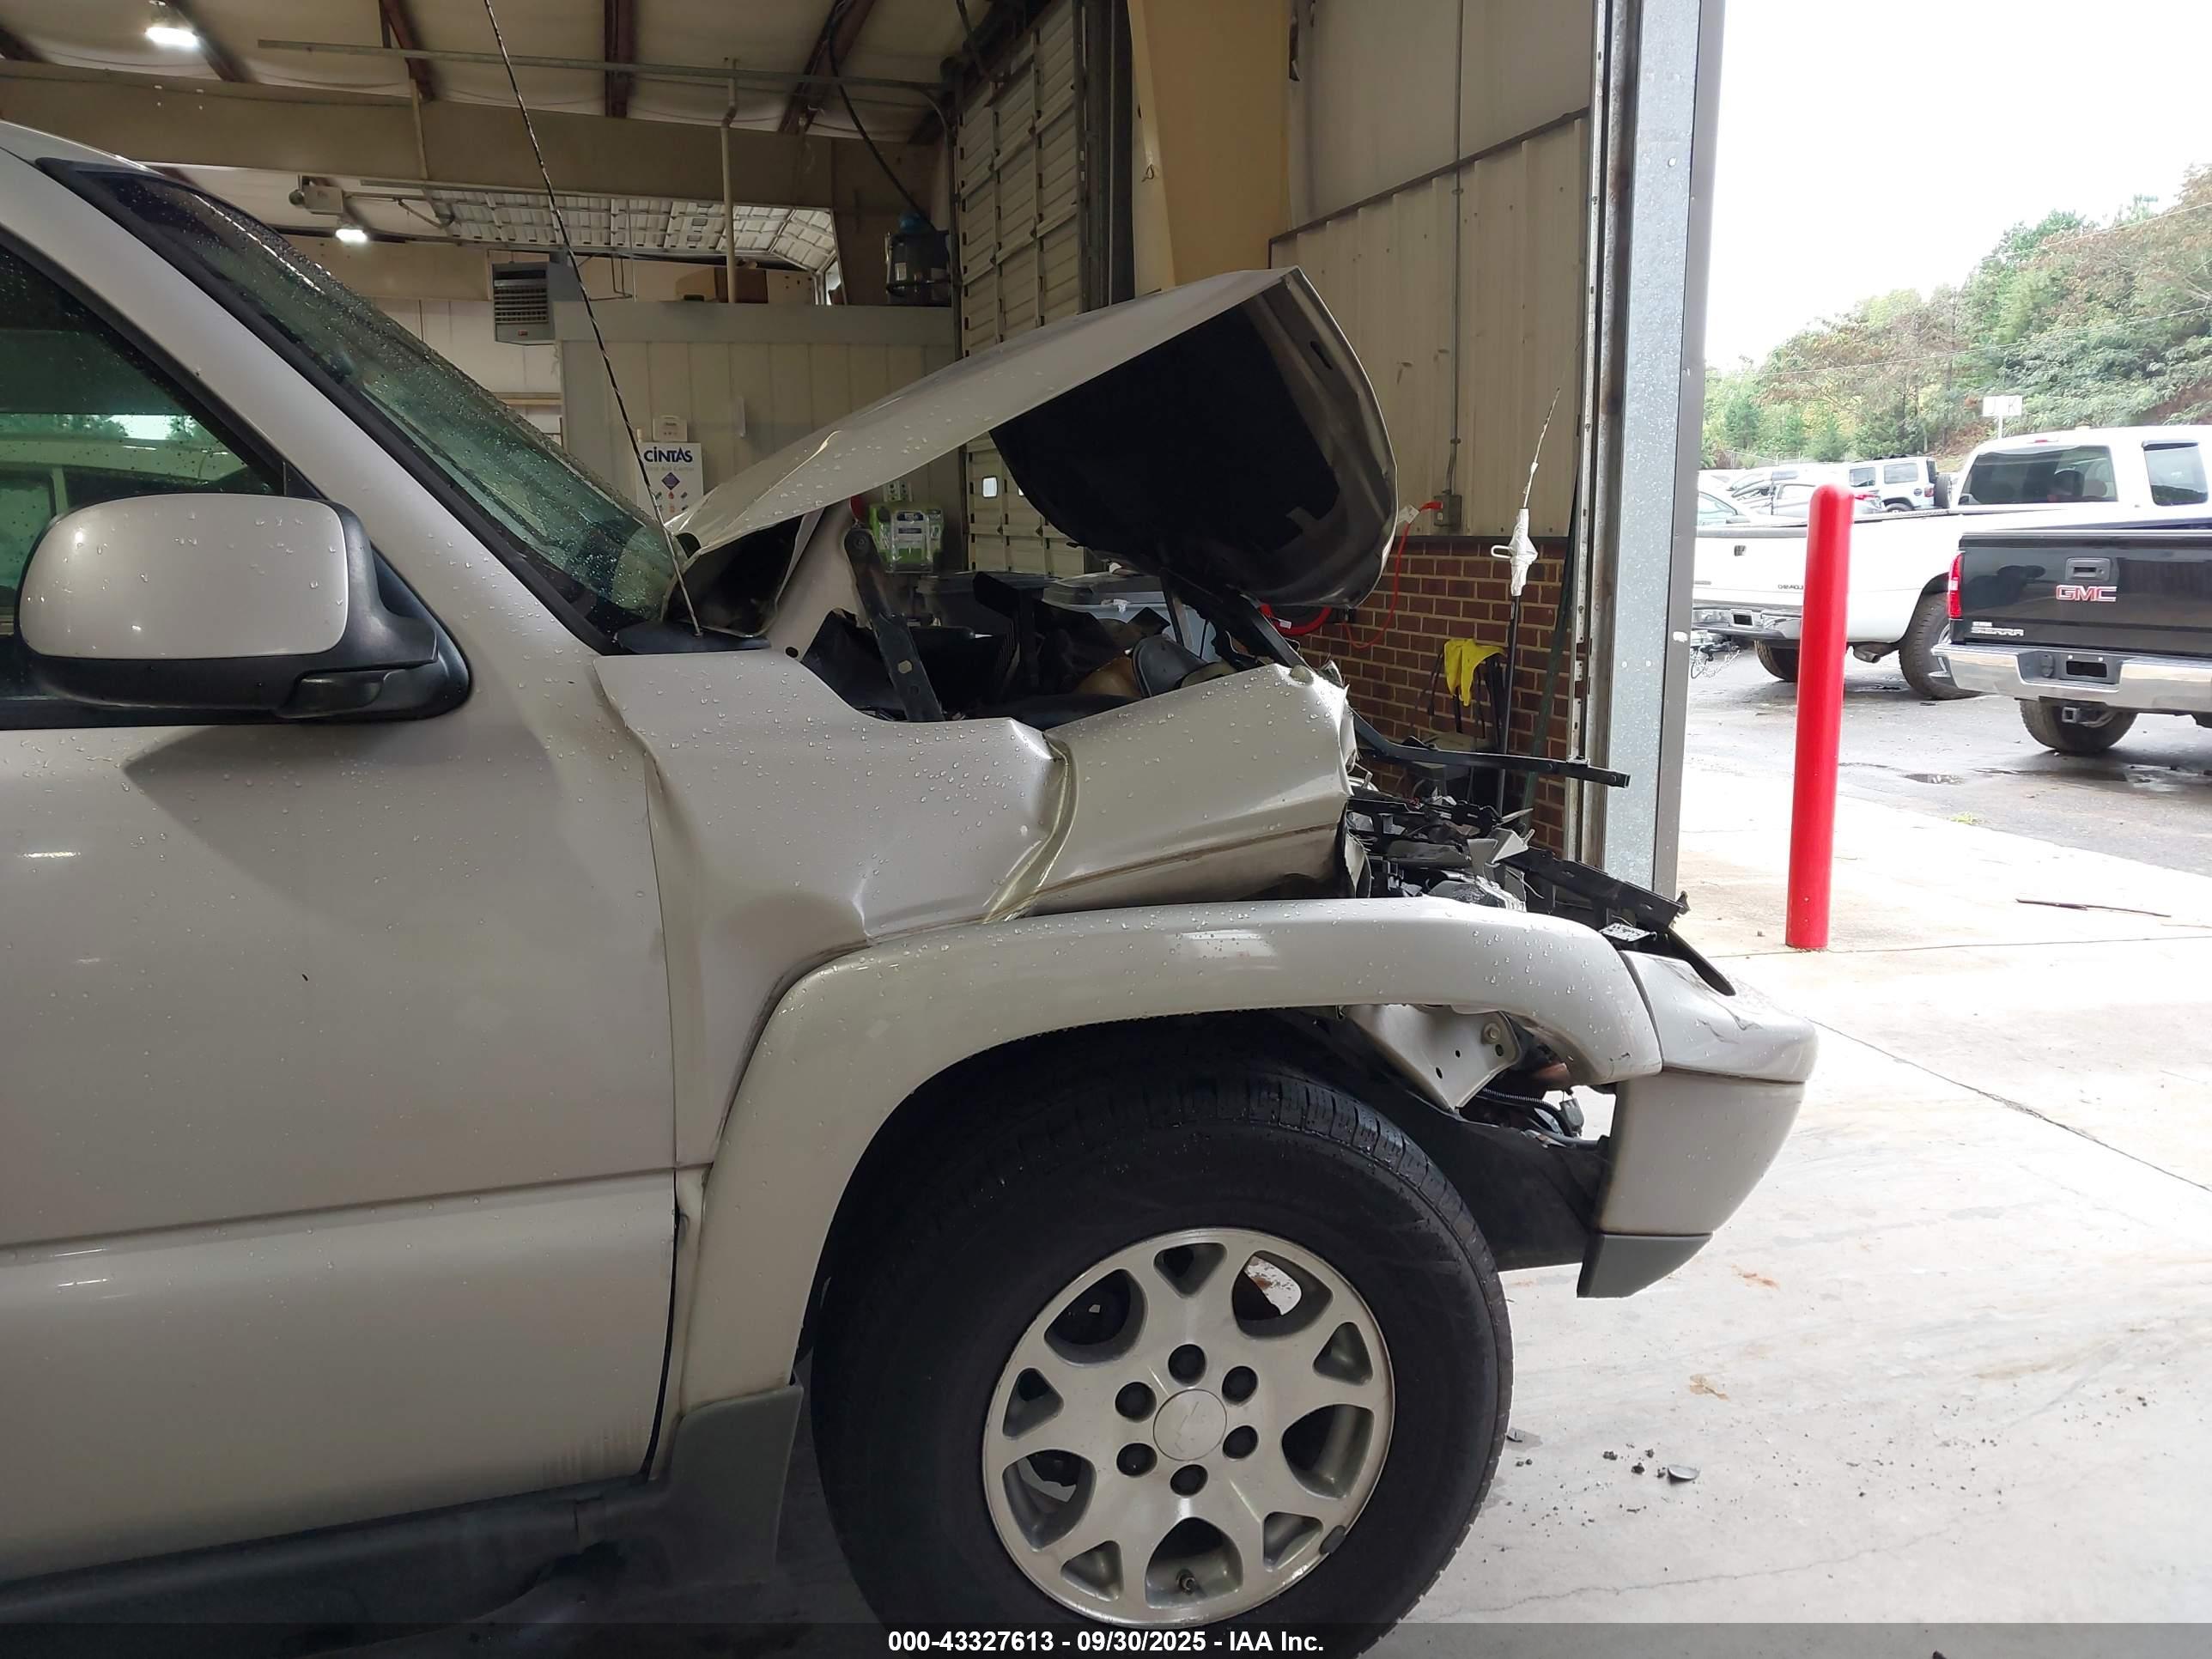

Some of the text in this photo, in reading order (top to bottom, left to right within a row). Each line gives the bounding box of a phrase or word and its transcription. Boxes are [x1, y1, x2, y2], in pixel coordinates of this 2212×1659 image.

[643, 447, 693, 462] CINTAS
[2056, 585, 2118, 602] GMC
[1971, 626, 2024, 636] SIERRA
